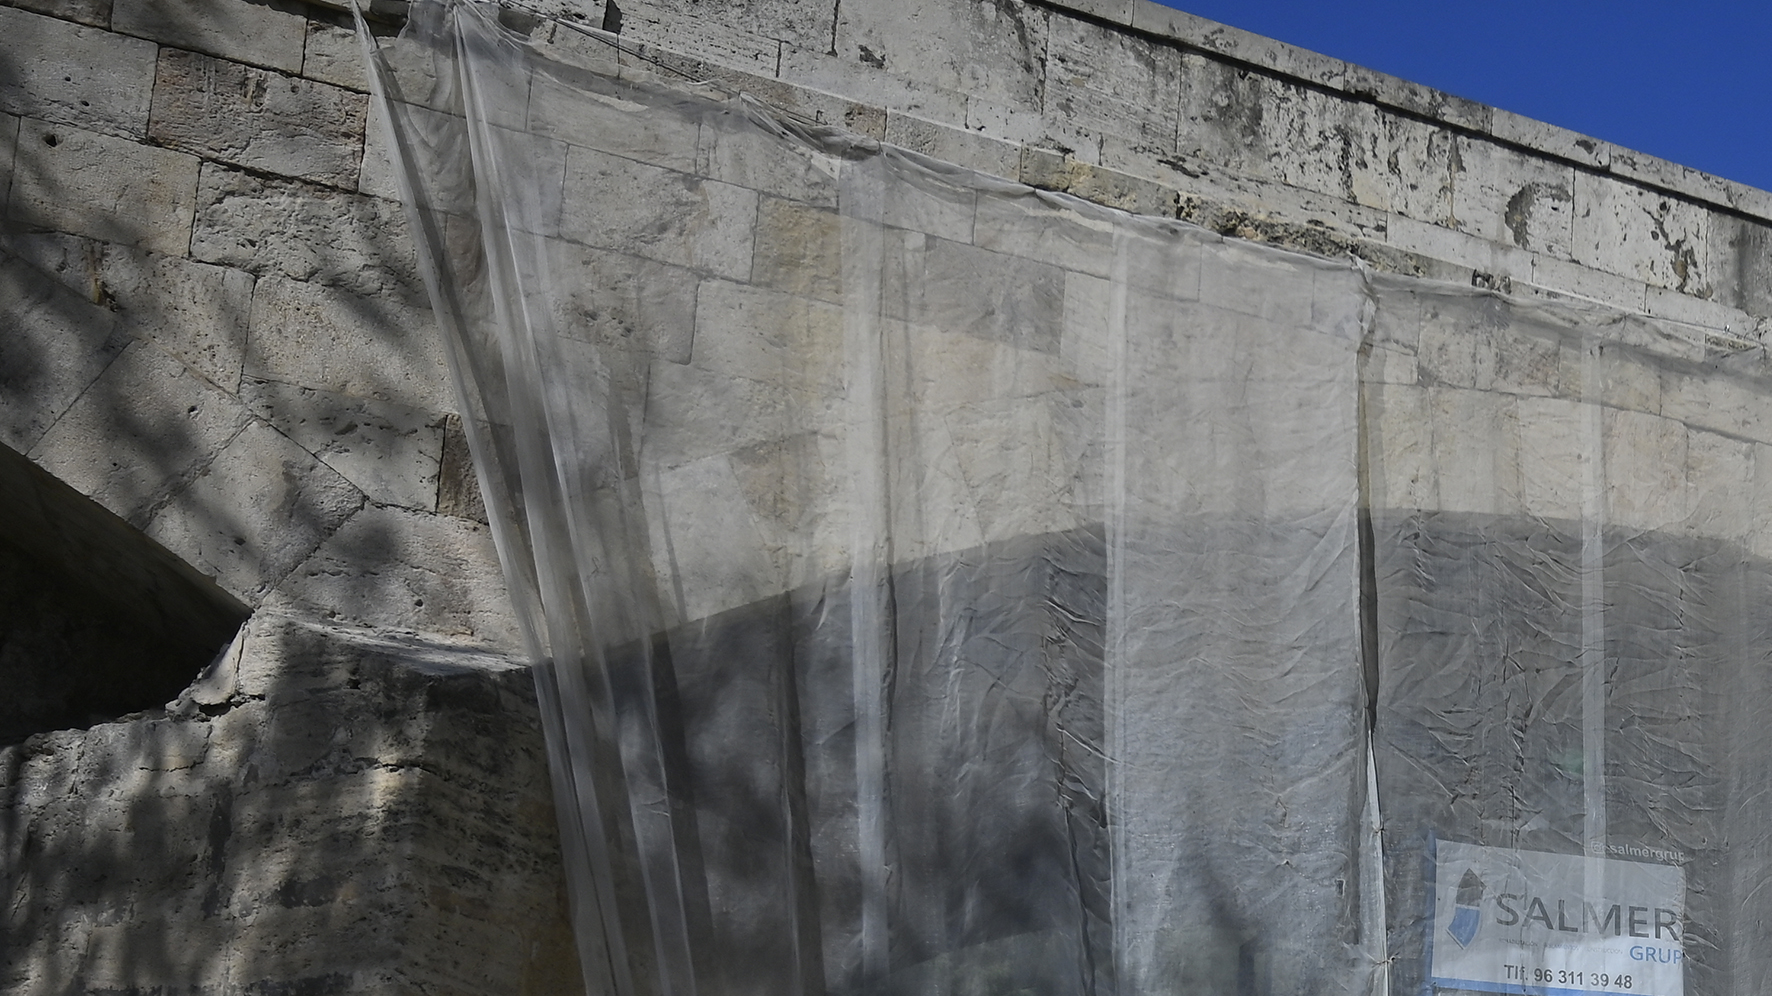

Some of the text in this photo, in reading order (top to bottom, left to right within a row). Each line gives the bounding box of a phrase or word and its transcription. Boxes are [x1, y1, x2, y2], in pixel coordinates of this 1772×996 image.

[1495, 893, 1682, 941] SALMER
[1630, 945, 1682, 965] GRUP
[1504, 964, 1633, 989] Tlf. 96 311 39 48
